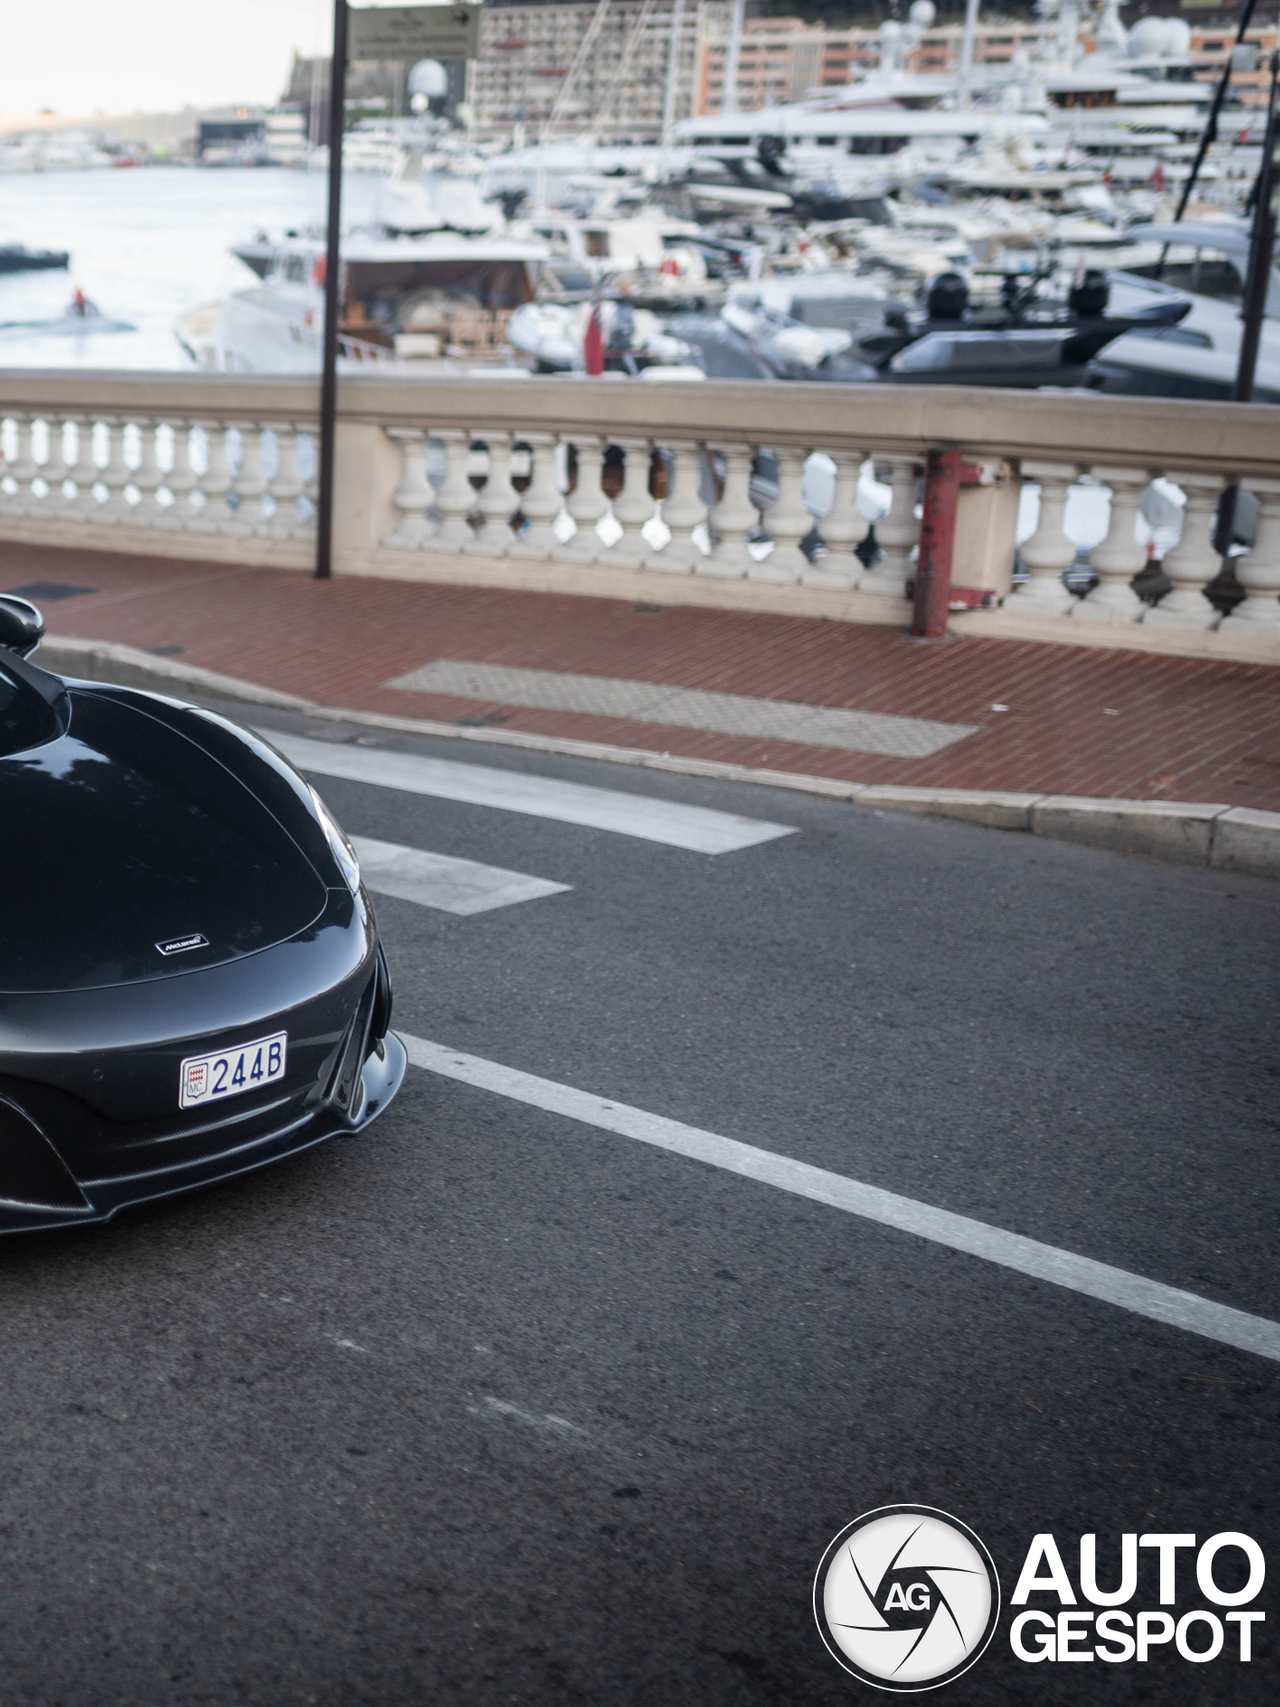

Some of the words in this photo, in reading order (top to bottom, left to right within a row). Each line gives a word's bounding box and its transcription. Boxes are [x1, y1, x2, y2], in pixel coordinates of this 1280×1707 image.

[165, 937, 201, 951] McLaren
[189, 1082, 203, 1094] MC
[211, 1041, 281, 1095] 244B
